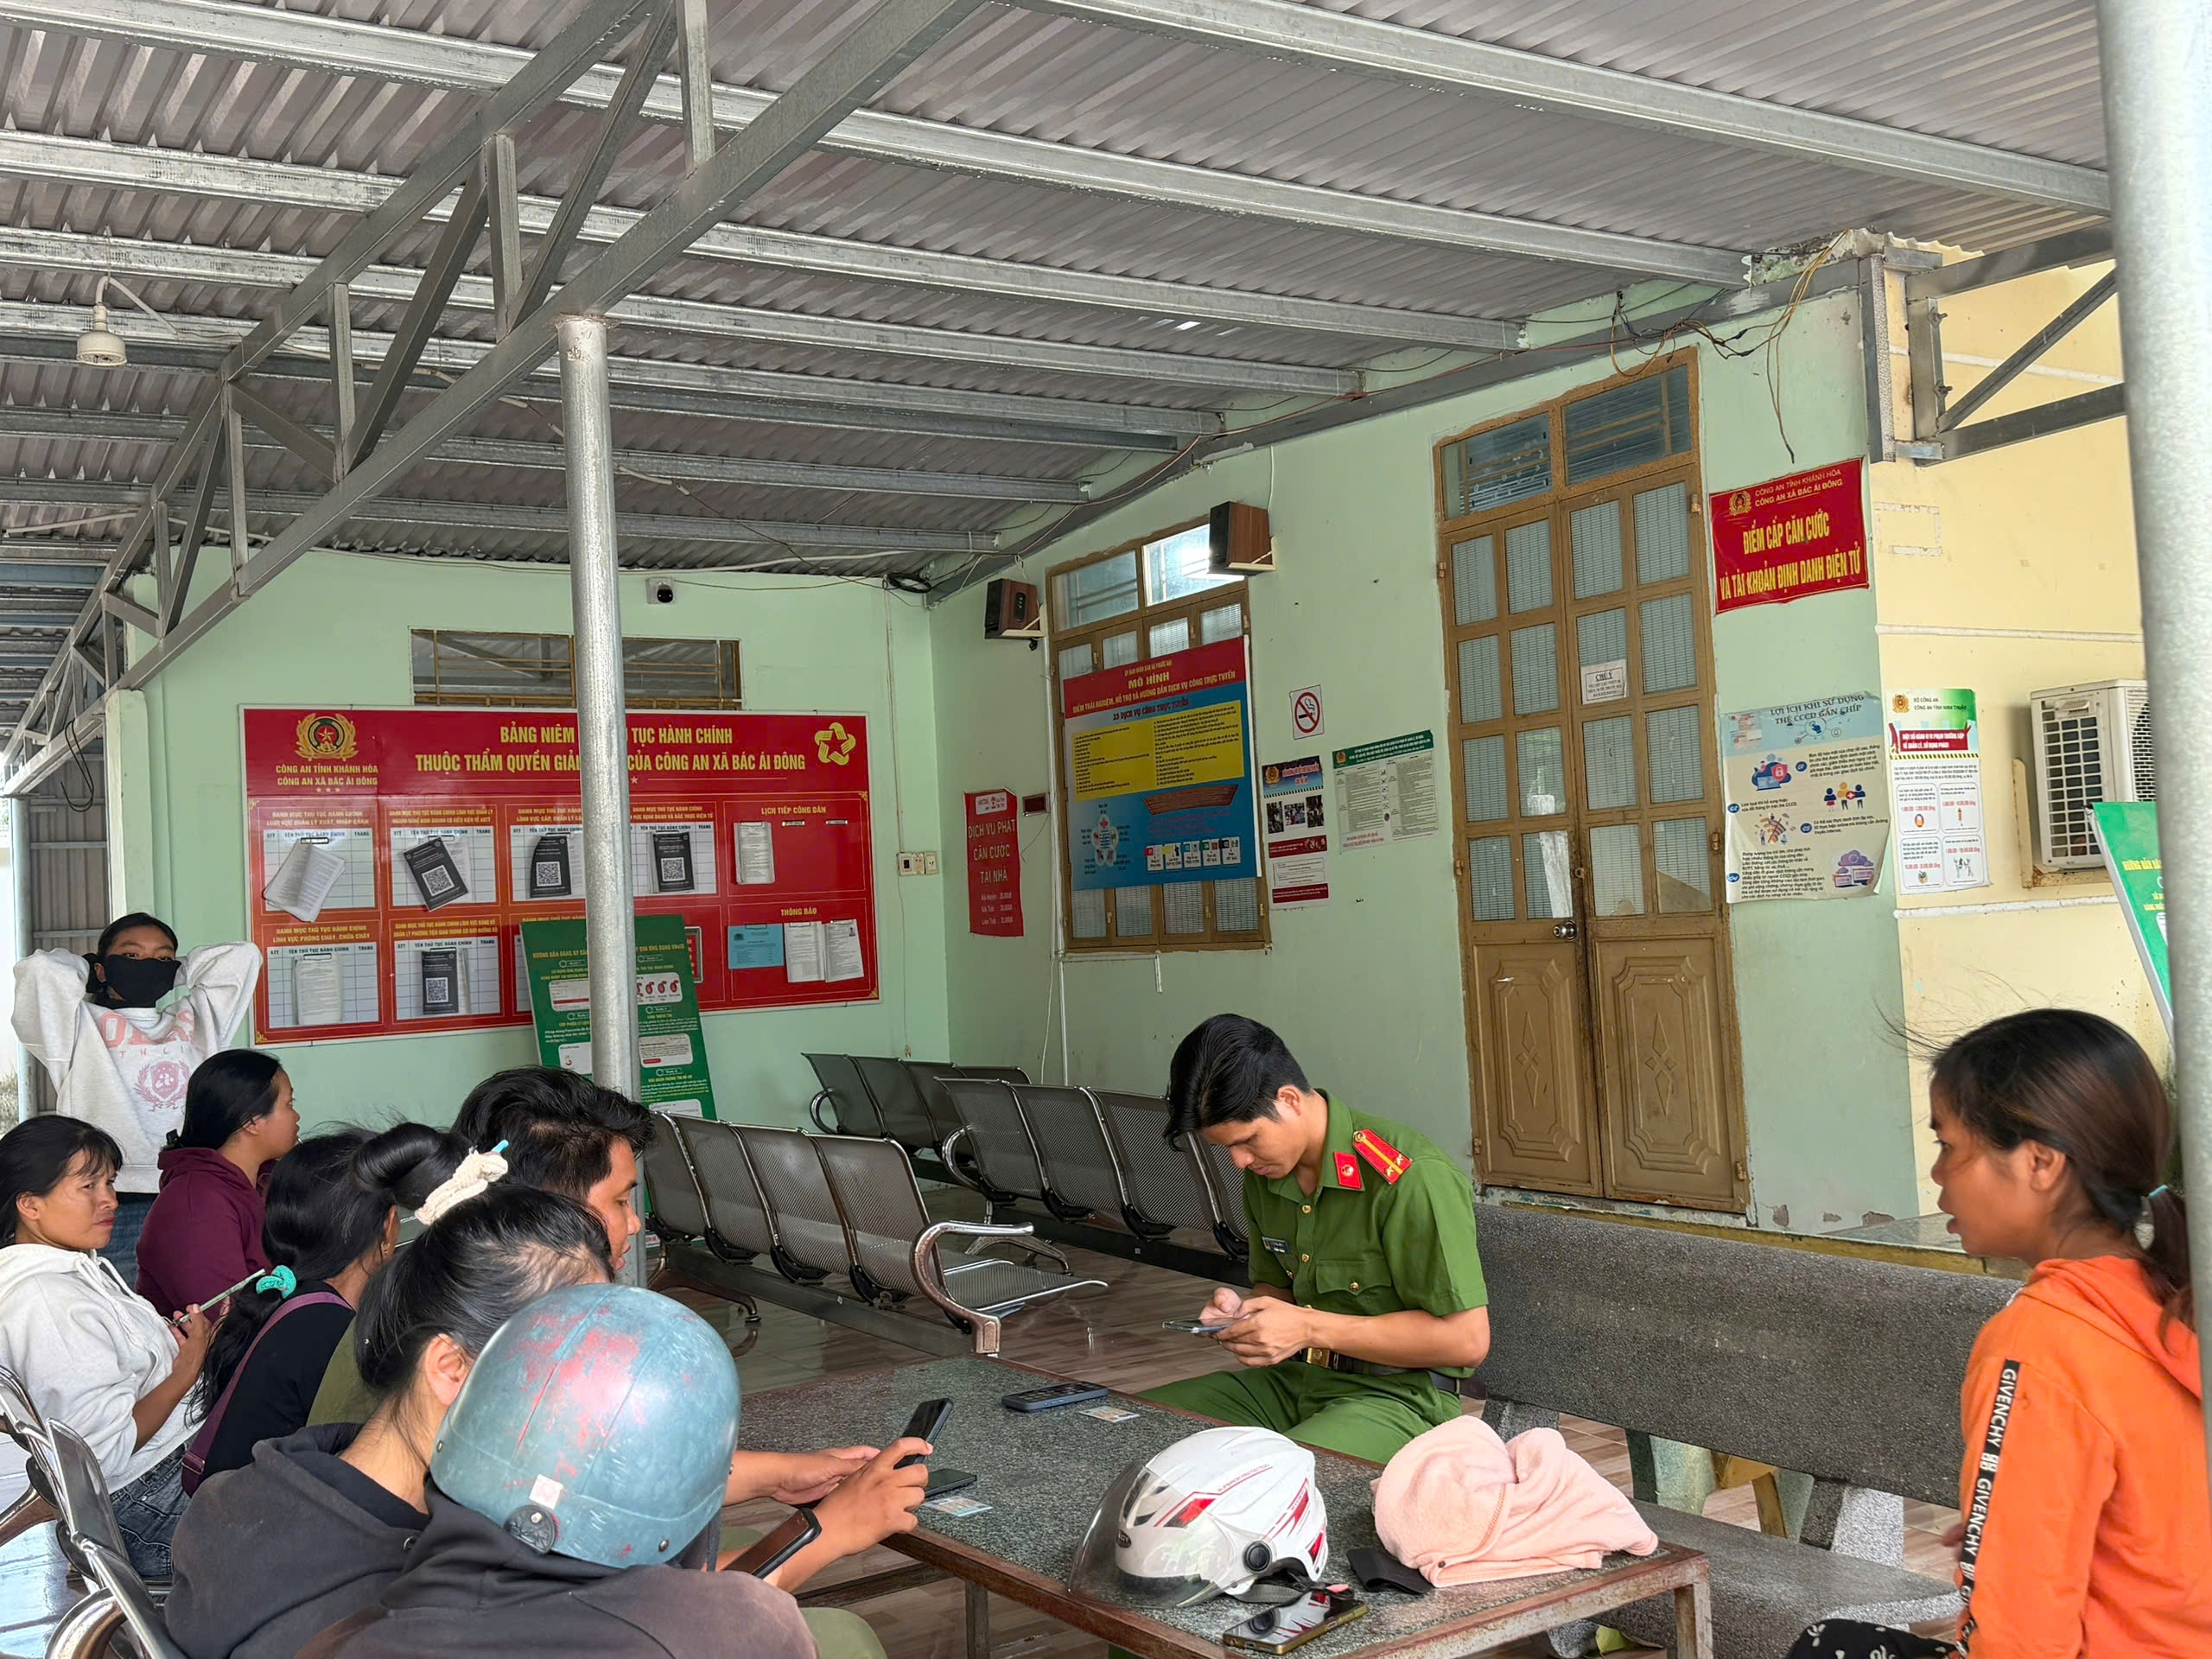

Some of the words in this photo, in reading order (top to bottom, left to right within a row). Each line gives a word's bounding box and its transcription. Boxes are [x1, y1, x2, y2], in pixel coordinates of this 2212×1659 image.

[1743, 519, 1765, 555] ĐIỂM
[1766, 516, 1783, 550] CẤP
[1786, 515, 1804, 544] CĂN
[1805, 508, 1829, 541] CƯỚC
[1720, 572, 1731, 601] VÀ
[1732, 569, 1745, 598] TÀI
[1746, 560, 1776, 594] KHOẢN
[1777, 564, 1798, 593] ĐỊNH
[1801, 556, 1824, 583] DANH
[1826, 549, 1847, 582] ĐIỆN
[1849, 541, 1860, 574] TỬ
[1128, 677, 1143, 689] MÔ
[1146, 672, 1169, 684] HÌNH
[1787, 705, 1802, 714] ÍCH
[1822, 697, 1834, 707] SỬ
[1838, 695, 1864, 704] DỤNG
[1776, 715, 1792, 724] THẺ
[1794, 713, 1816, 721] CCCD
[500, 721, 537, 743] BẢNG
[541, 724, 574, 742] NIÊM
[632, 729, 654, 747] TỤC
[658, 726, 691, 744] HÀNH
[696, 726, 733, 744] CHÍNH
[276, 764, 297, 773] CÔNG
[314, 763, 331, 772] TỈNH
[334, 764, 360, 772] KHÁNH
[416, 753, 460, 774] THUỘC
[464, 748, 503, 771] THẨM
[507, 749, 550, 772] QUYỀN
[627, 749, 650, 771] CỦA
[656, 752, 689, 771] CÔNG
[693, 755, 709, 771] AN
[713, 752, 729, 770] XÃ
[733, 751, 755, 771] BÁC
[759, 751, 771, 770] ÁI
[774, 751, 805, 770] ĐÔNG
[277, 777, 299, 785] CÔNG
[781, 907, 802, 916] THÔNG
[804, 906, 817, 915] BÁO
[1987, 1368, 2017, 1446] GIVENCHY
[1963, 1478, 1992, 1557] GIVENCHY
